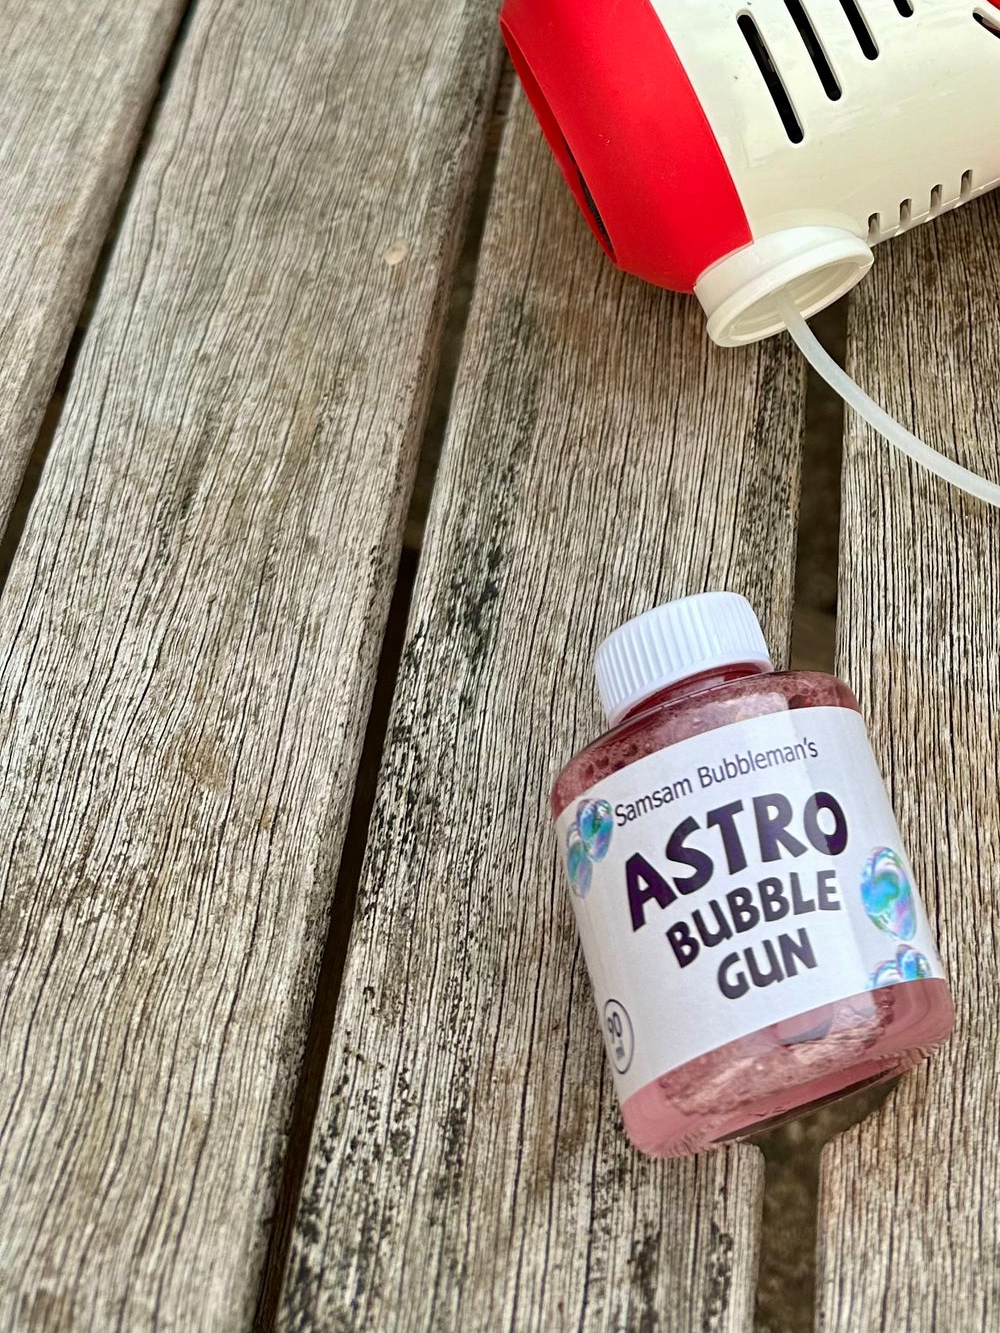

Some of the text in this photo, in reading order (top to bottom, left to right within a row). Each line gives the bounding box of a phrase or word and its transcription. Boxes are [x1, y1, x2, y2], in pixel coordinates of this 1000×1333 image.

[615, 737, 819, 827] Samsam Bubbleman's
[624, 791, 849, 933] ASTRO
[665, 869, 842, 969] BUBBLE
[717, 926, 818, 1001] GUN
[607, 1011, 623, 1044] 90
